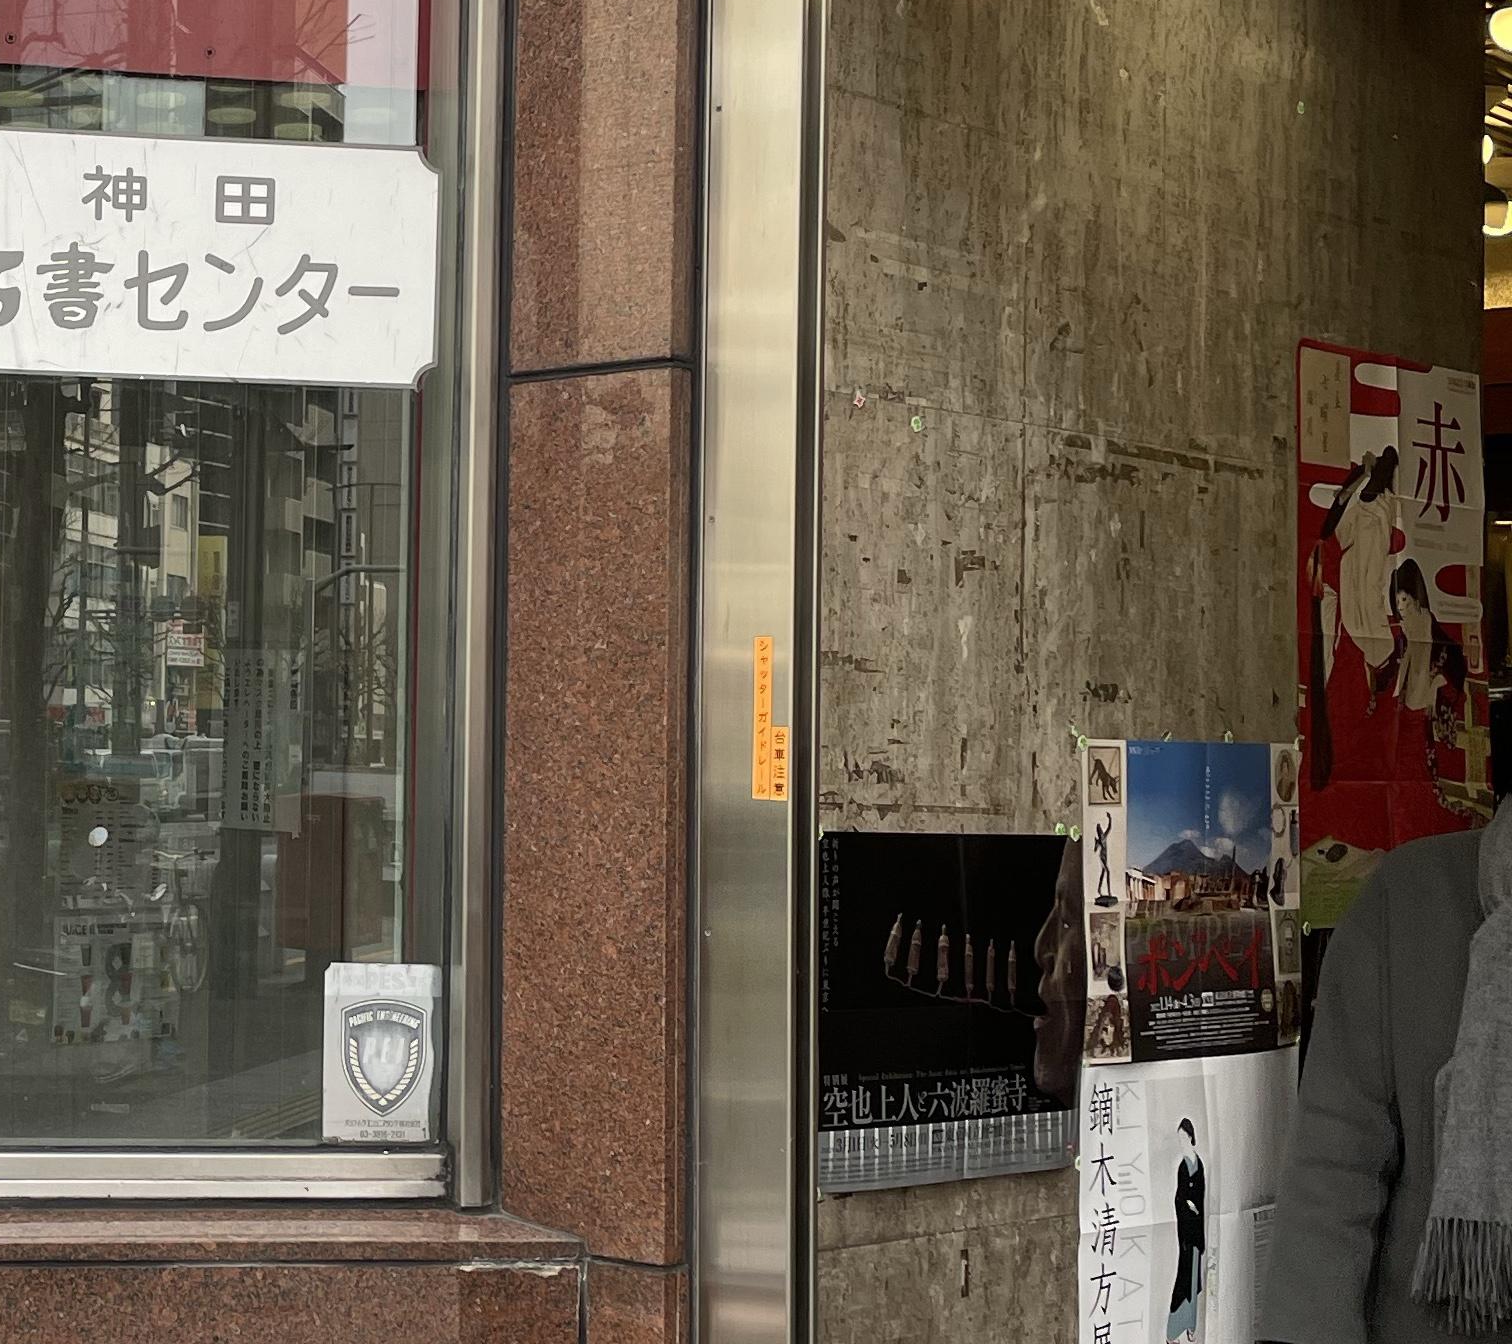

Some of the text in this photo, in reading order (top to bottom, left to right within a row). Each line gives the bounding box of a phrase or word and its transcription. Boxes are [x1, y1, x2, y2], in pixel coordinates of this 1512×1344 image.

[81, 164, 276, 225] 神田
[1412, 401, 1465, 523] 赤
[756, 640, 769, 794] シャッターガイドレール
[1138, 928, 1265, 996] ポンペイ
[822, 1074, 1028, 1127] 空也上人と六波羅蜜寺
